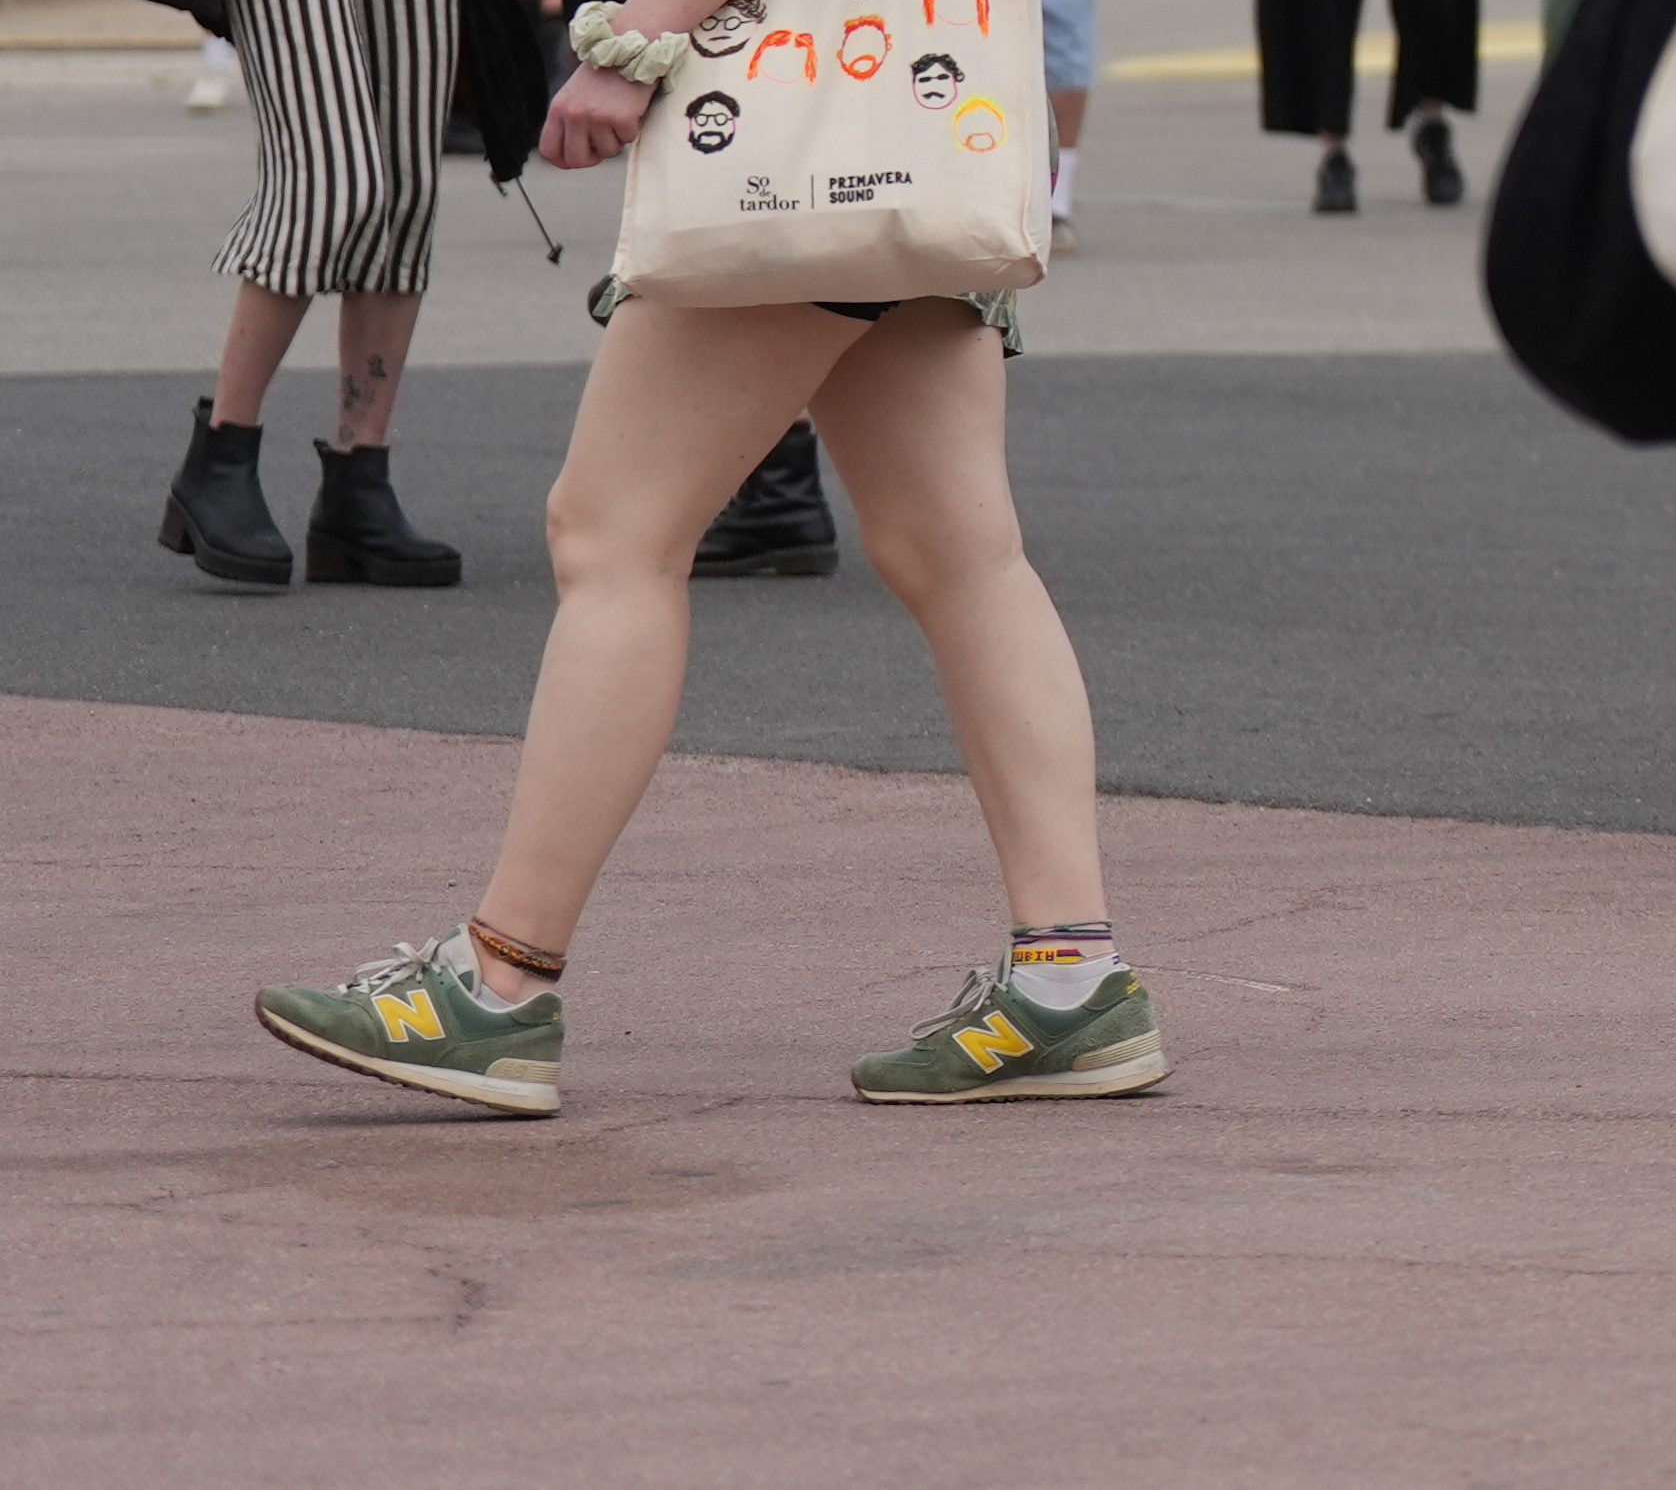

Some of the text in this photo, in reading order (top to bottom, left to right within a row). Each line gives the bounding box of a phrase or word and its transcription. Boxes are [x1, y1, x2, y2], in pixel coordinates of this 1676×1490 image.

[829, 171, 912, 190] PRIMAVERA
[740, 194, 800, 211] tardor
[829, 188, 874, 204] SOUND
[371, 988, 446, 1043] N
[952, 1010, 1034, 1074] N
